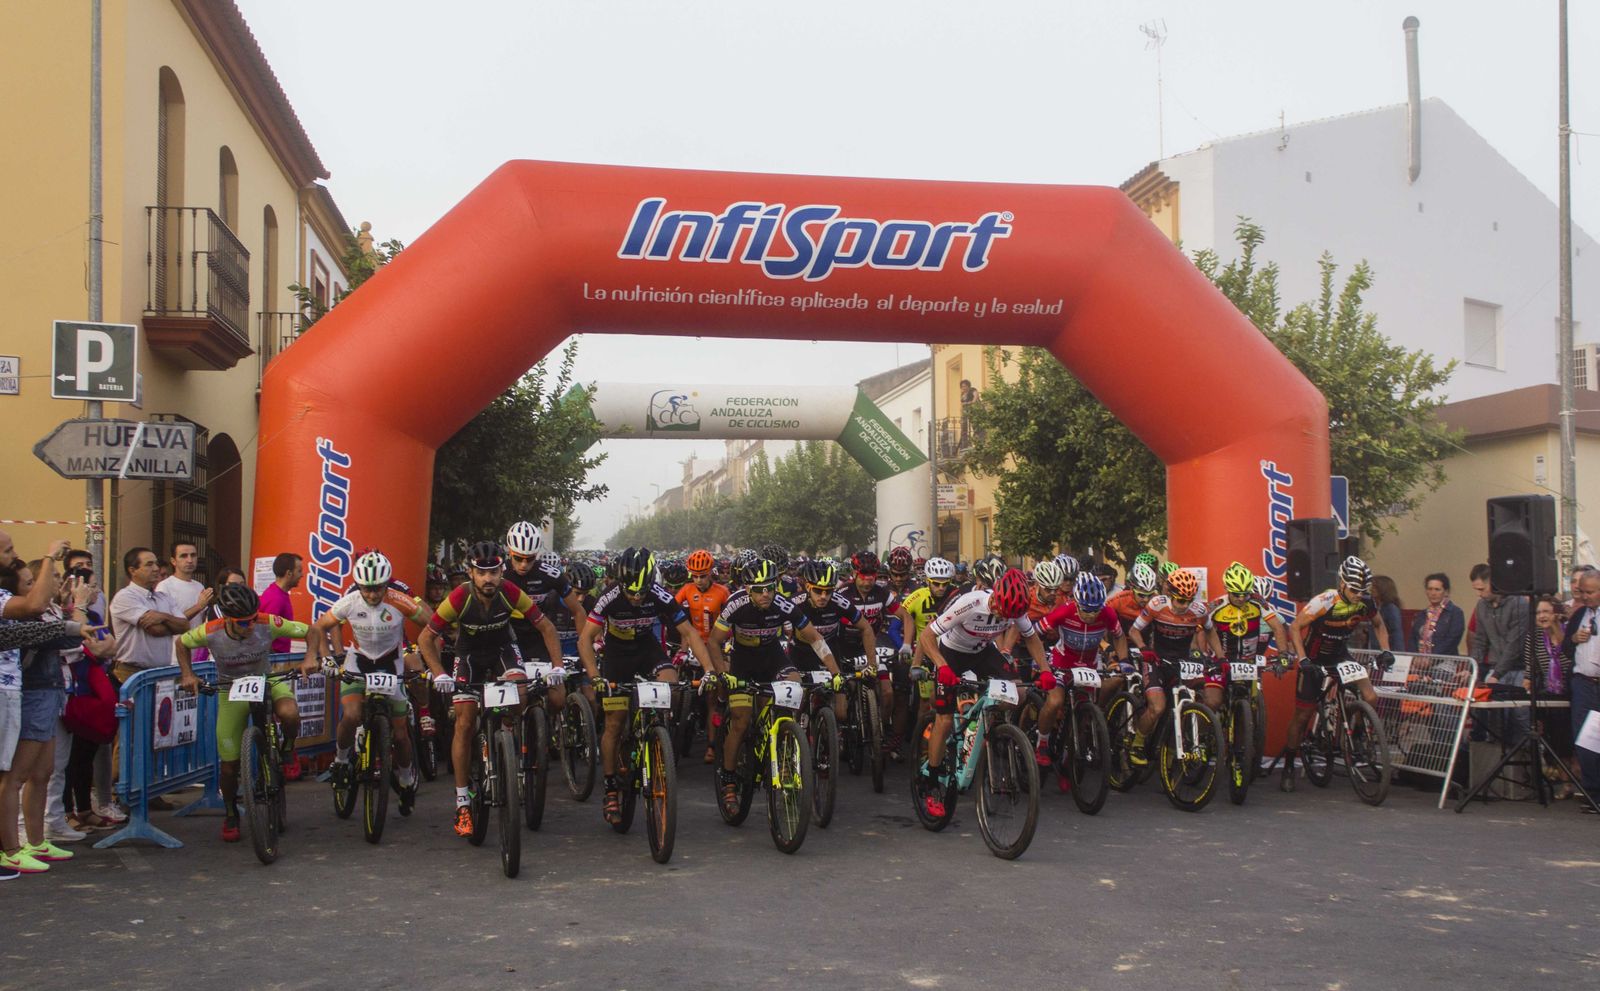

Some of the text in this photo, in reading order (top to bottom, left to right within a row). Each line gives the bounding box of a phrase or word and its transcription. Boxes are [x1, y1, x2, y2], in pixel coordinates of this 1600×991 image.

[583, 282, 1063, 318] La nutrición científica aplicada al deporte y la salud
[76, 329, 114, 391] P
[726, 397, 799, 407] FEDERACION
[710, 408, 773, 418] ANDALUZA
[728, 419, 800, 429] DE CICLISMO
[84, 426, 188, 450] HUELVA
[854, 416, 892, 453] ANDALUZA
[868, 418, 911, 461] FEDERACION
[859, 431, 901, 472] DE CICLISMO
[1181, 662, 1202, 675] 2178
[1232, 664, 1255, 673] 1465
[368, 675, 394, 687] 1571
[1079, 671, 1095, 681] 119
[238, 682, 259, 694] 116
[786, 686, 793, 698] 2
[1000, 681, 1007, 693] 3
[498, 689, 506, 704] 7
[651, 688, 658, 699] 1
